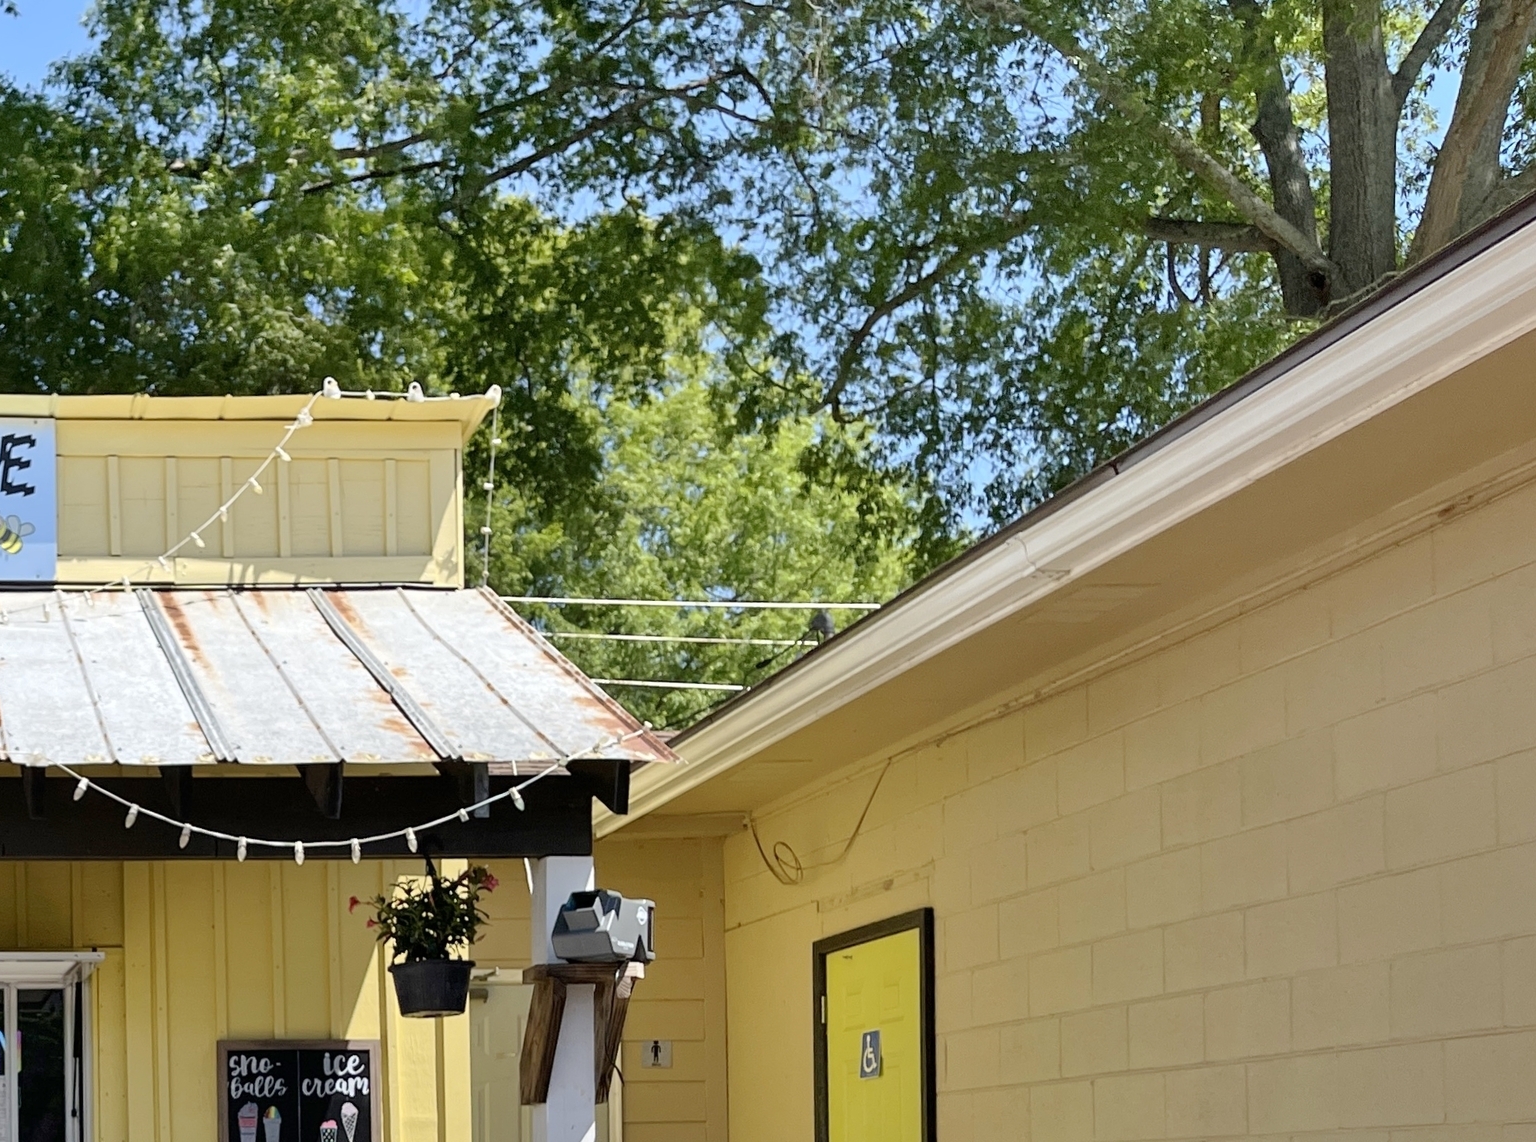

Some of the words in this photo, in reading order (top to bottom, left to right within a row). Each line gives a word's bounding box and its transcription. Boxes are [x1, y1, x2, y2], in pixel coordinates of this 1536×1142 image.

[323, 1052, 365, 1076] ice
[230, 1075, 288, 1099] balls
[302, 1076, 369, 1098] cream
